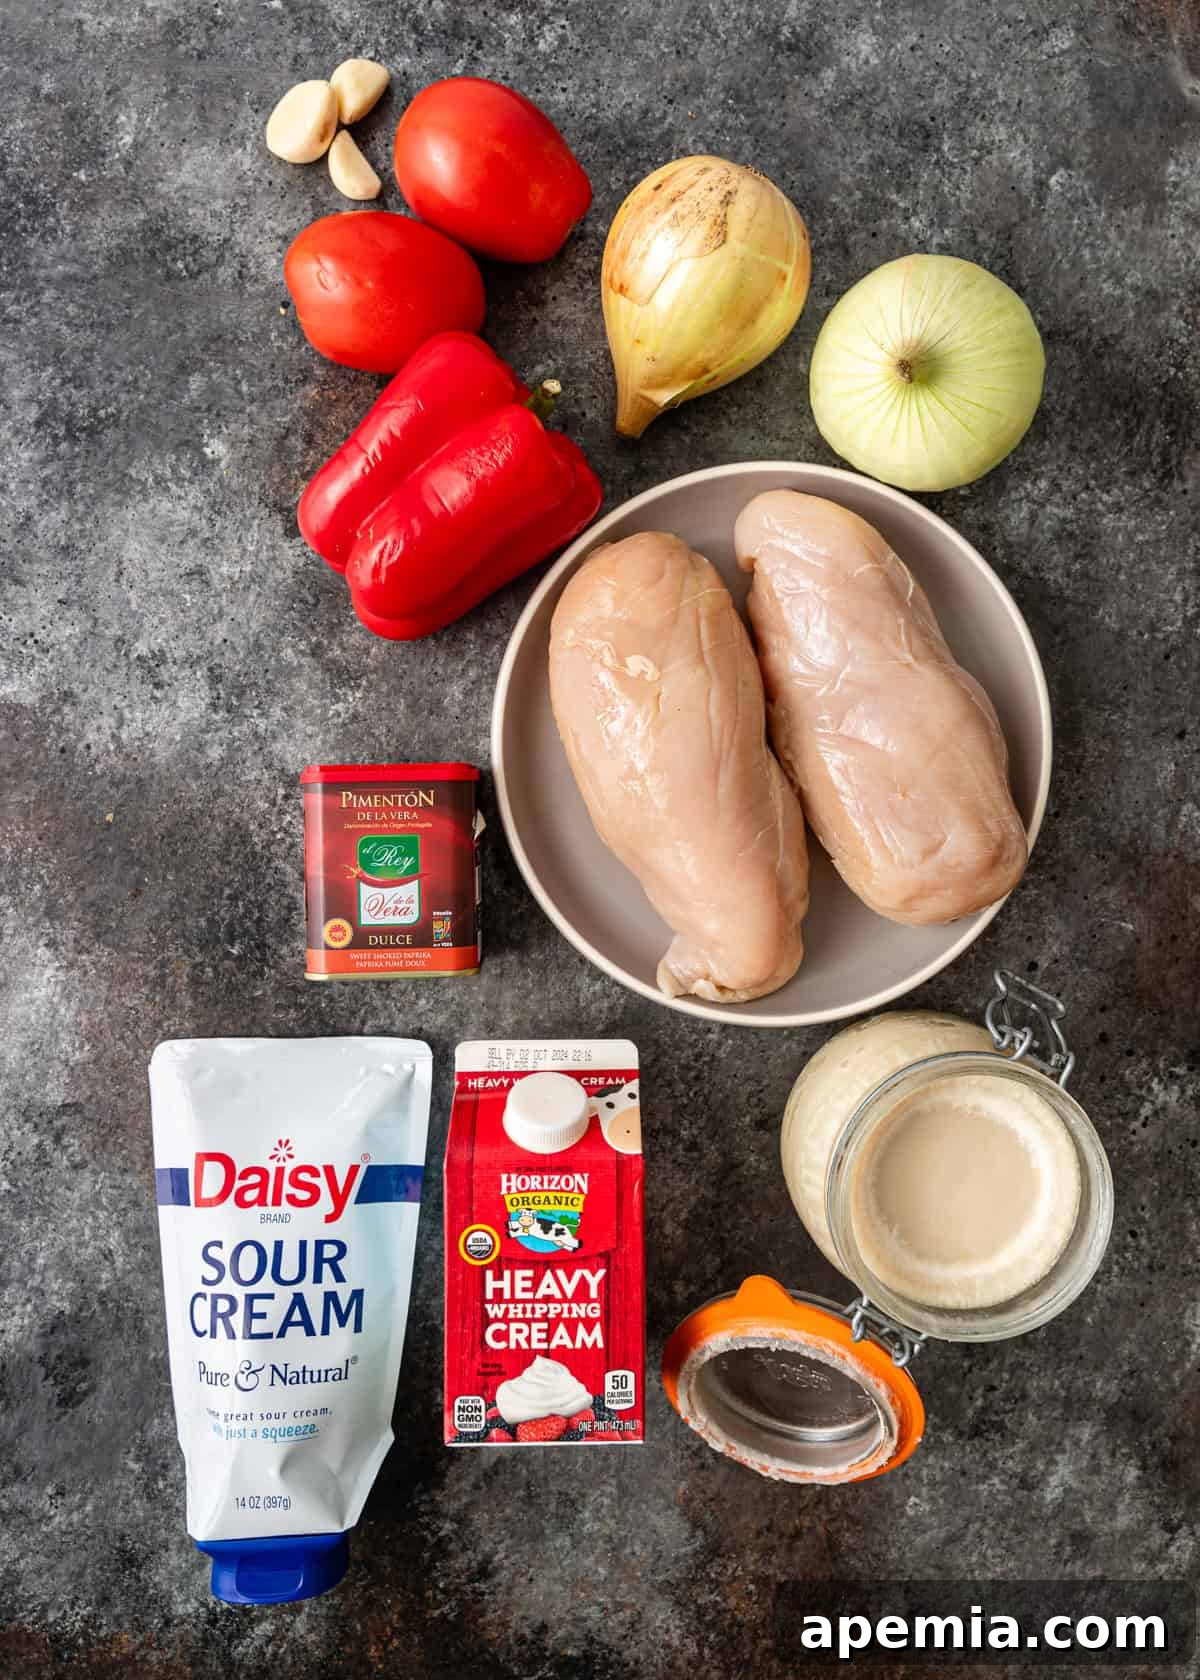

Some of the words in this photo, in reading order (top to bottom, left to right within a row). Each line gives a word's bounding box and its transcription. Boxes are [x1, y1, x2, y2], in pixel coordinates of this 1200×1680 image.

[340, 790, 435, 808] PIMENTÓN
[357, 812, 374, 821] DE
[375, 812, 387, 821] LA
[390, 811, 419, 820] VERA
[371, 844, 416, 873] Rey
[365, 893, 412, 920] Vera
[368, 935, 413, 945] DULCE
[467, 1077, 510, 1089] HEAVY
[581, 1076, 627, 1086] CREAM
[500, 1173, 589, 1195] HORIZON
[509, 1195, 580, 1208] ORGANIC
[259, 1213, 292, 1225] BRAND
[201, 1239, 348, 1288] SOUR
[484, 1269, 607, 1300] HEAVY
[189, 1288, 365, 1341] CREAM
[484, 1303, 601, 1319] WHIPPING
[484, 1322, 605, 1350] CREAM
[198, 1360, 230, 1388] Pure
[234, 1359, 265, 1392] &
[611, 1374, 628, 1390] 50
[224, 1411, 253, 1423] great
[260, 1411, 288, 1421] sour
[457, 1405, 482, 1414] NON
[457, 1414, 482, 1423] GMO
[578, 1420, 592, 1432] ONE
[593, 1420, 608, 1432] PINT
[225, 1425, 247, 1440] just
[250, 1428, 258, 1439] a
[235, 1496, 246, 1510] 14
[248, 1496, 262, 1510] OZ
[263, 1495, 292, 1511] (397g)
